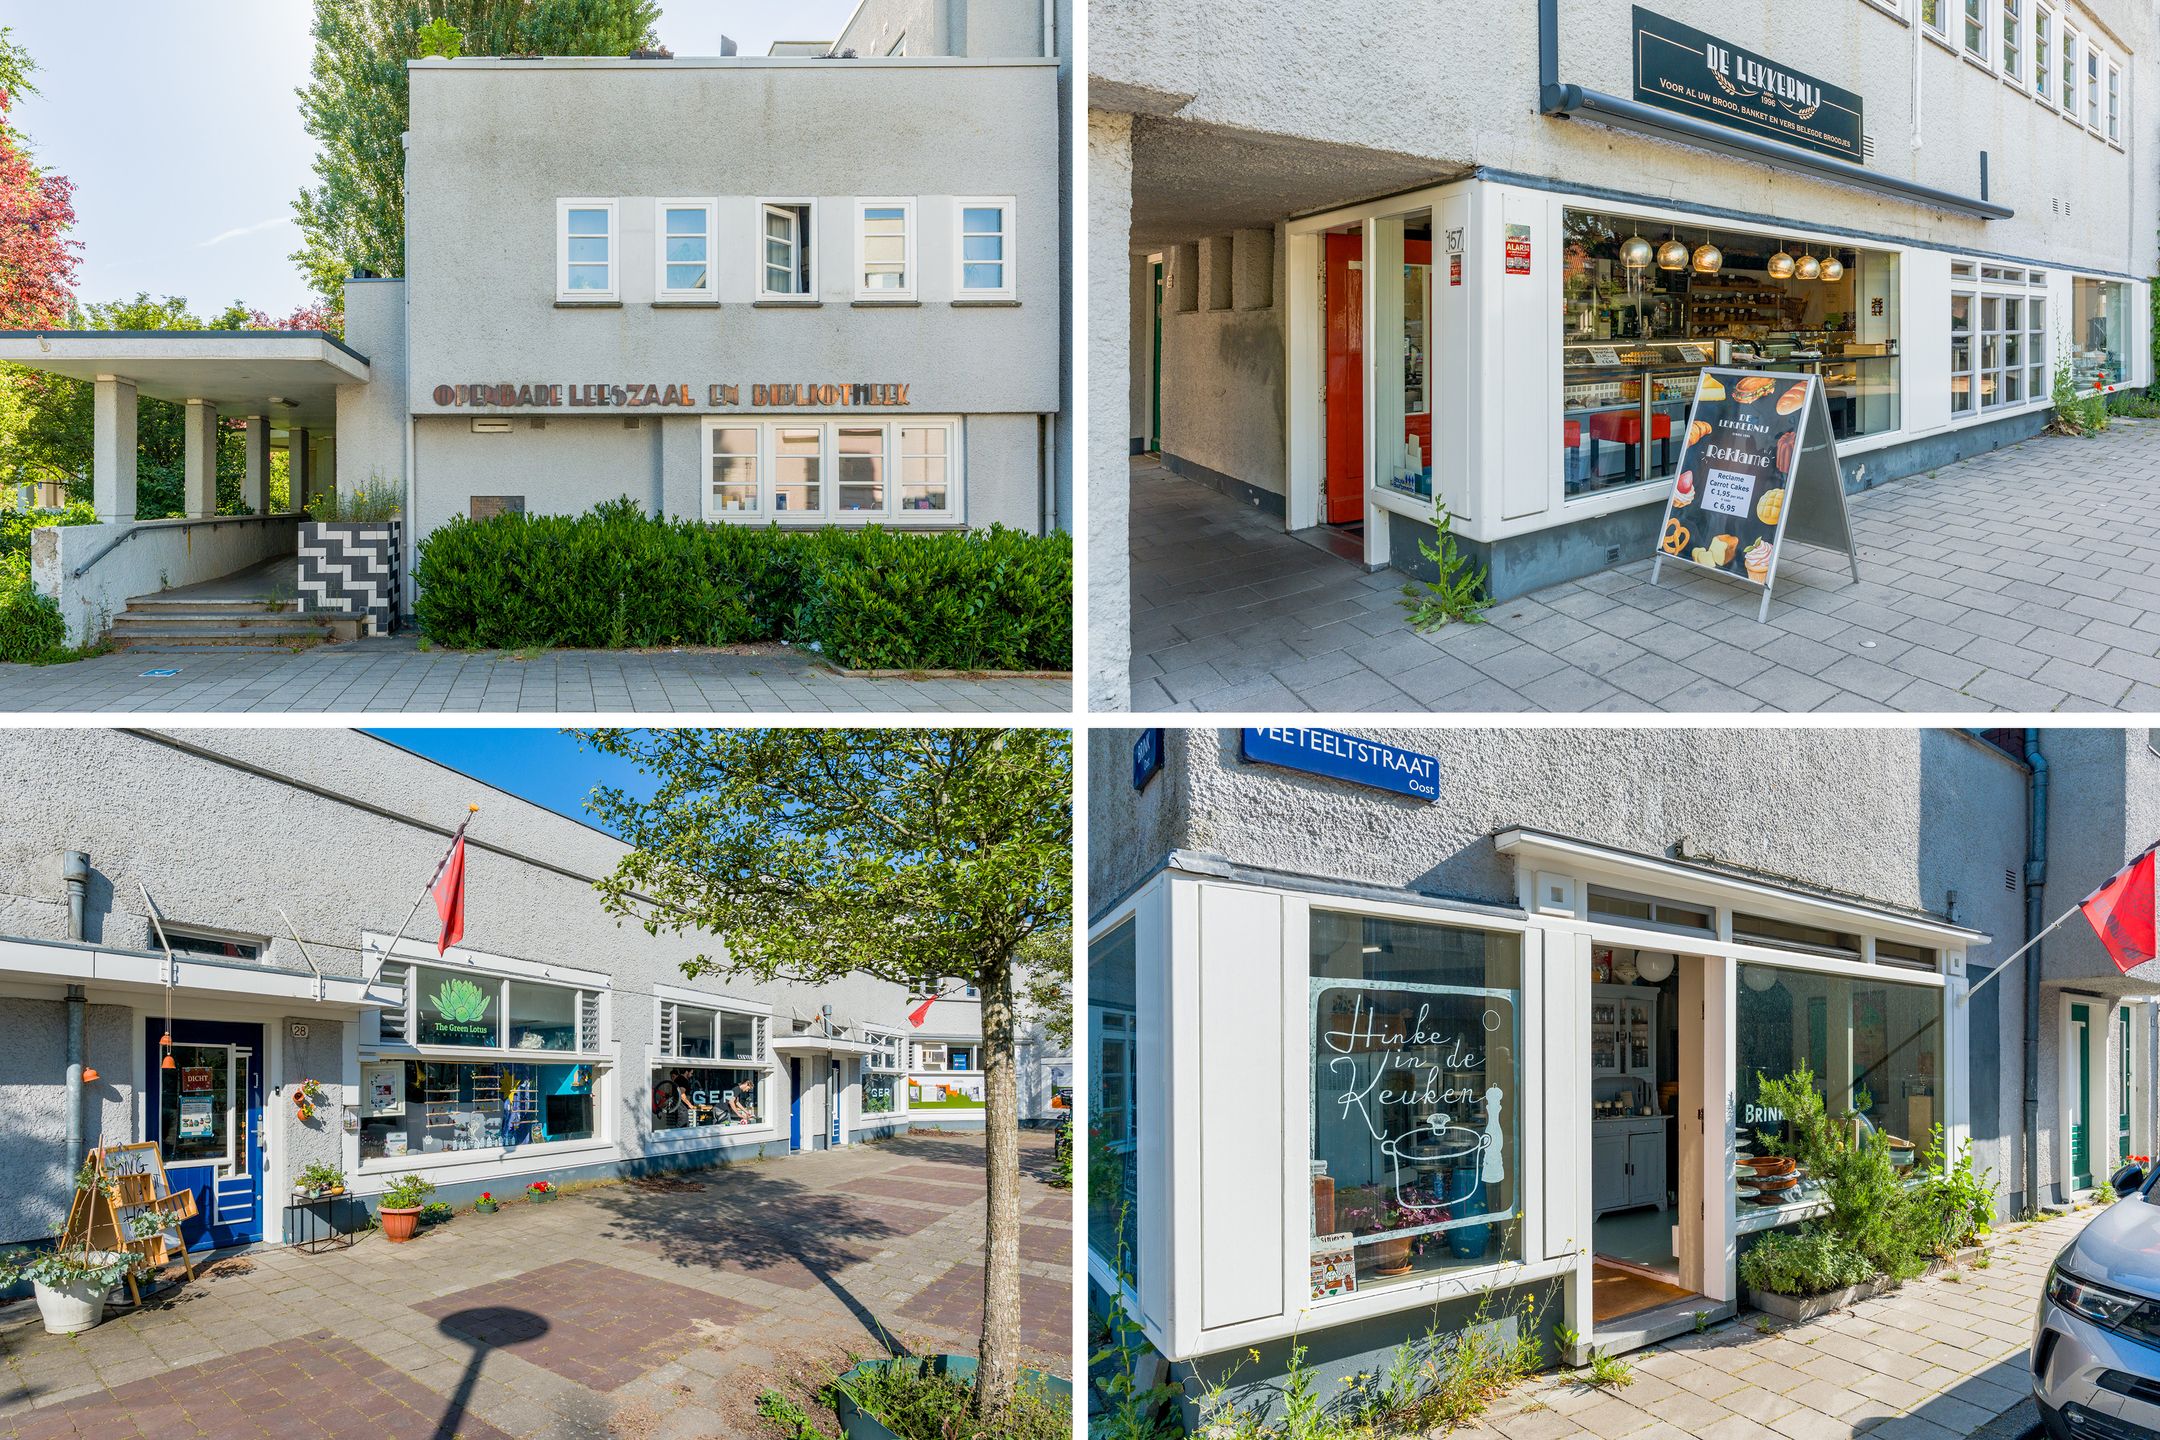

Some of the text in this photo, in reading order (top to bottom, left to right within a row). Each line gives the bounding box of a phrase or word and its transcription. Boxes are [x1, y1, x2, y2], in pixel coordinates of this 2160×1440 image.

[1706, 43, 1821, 108] DE LEKKERNIJ
[1760, 95, 1777, 108] 1996
[1659, 77, 1851, 148] VOOR AL UW BROOD, BANKET EN VERS BELEGDE BROODJES
[1446, 229, 1463, 251] 157
[433, 383, 911, 407] OPENBARE LEESZAAL EN BIBLIOTHEEK
[1739, 413, 1752, 423] DE
[1718, 419, 1770, 434] LEKKERNIJ
[1705, 444, 1770, 468] Reklame
[1717, 472, 1745, 483] Reclame
[1709, 479, 1750, 493] Carrot Cakes
[1716, 489, 1731, 498] 1,95
[1713, 501, 1736, 513] € 6,95
[1408, 779, 1435, 795] Oost
[294, 1025, 306, 1036] 28
[434, 1022, 488, 1034] The Green Lotus
[1324, 994, 1451, 1054] Hinke
[1395, 1038, 1487, 1068] in de
[871, 1088, 891, 1098] GER
[1330, 1048, 1487, 1140] Keuken
